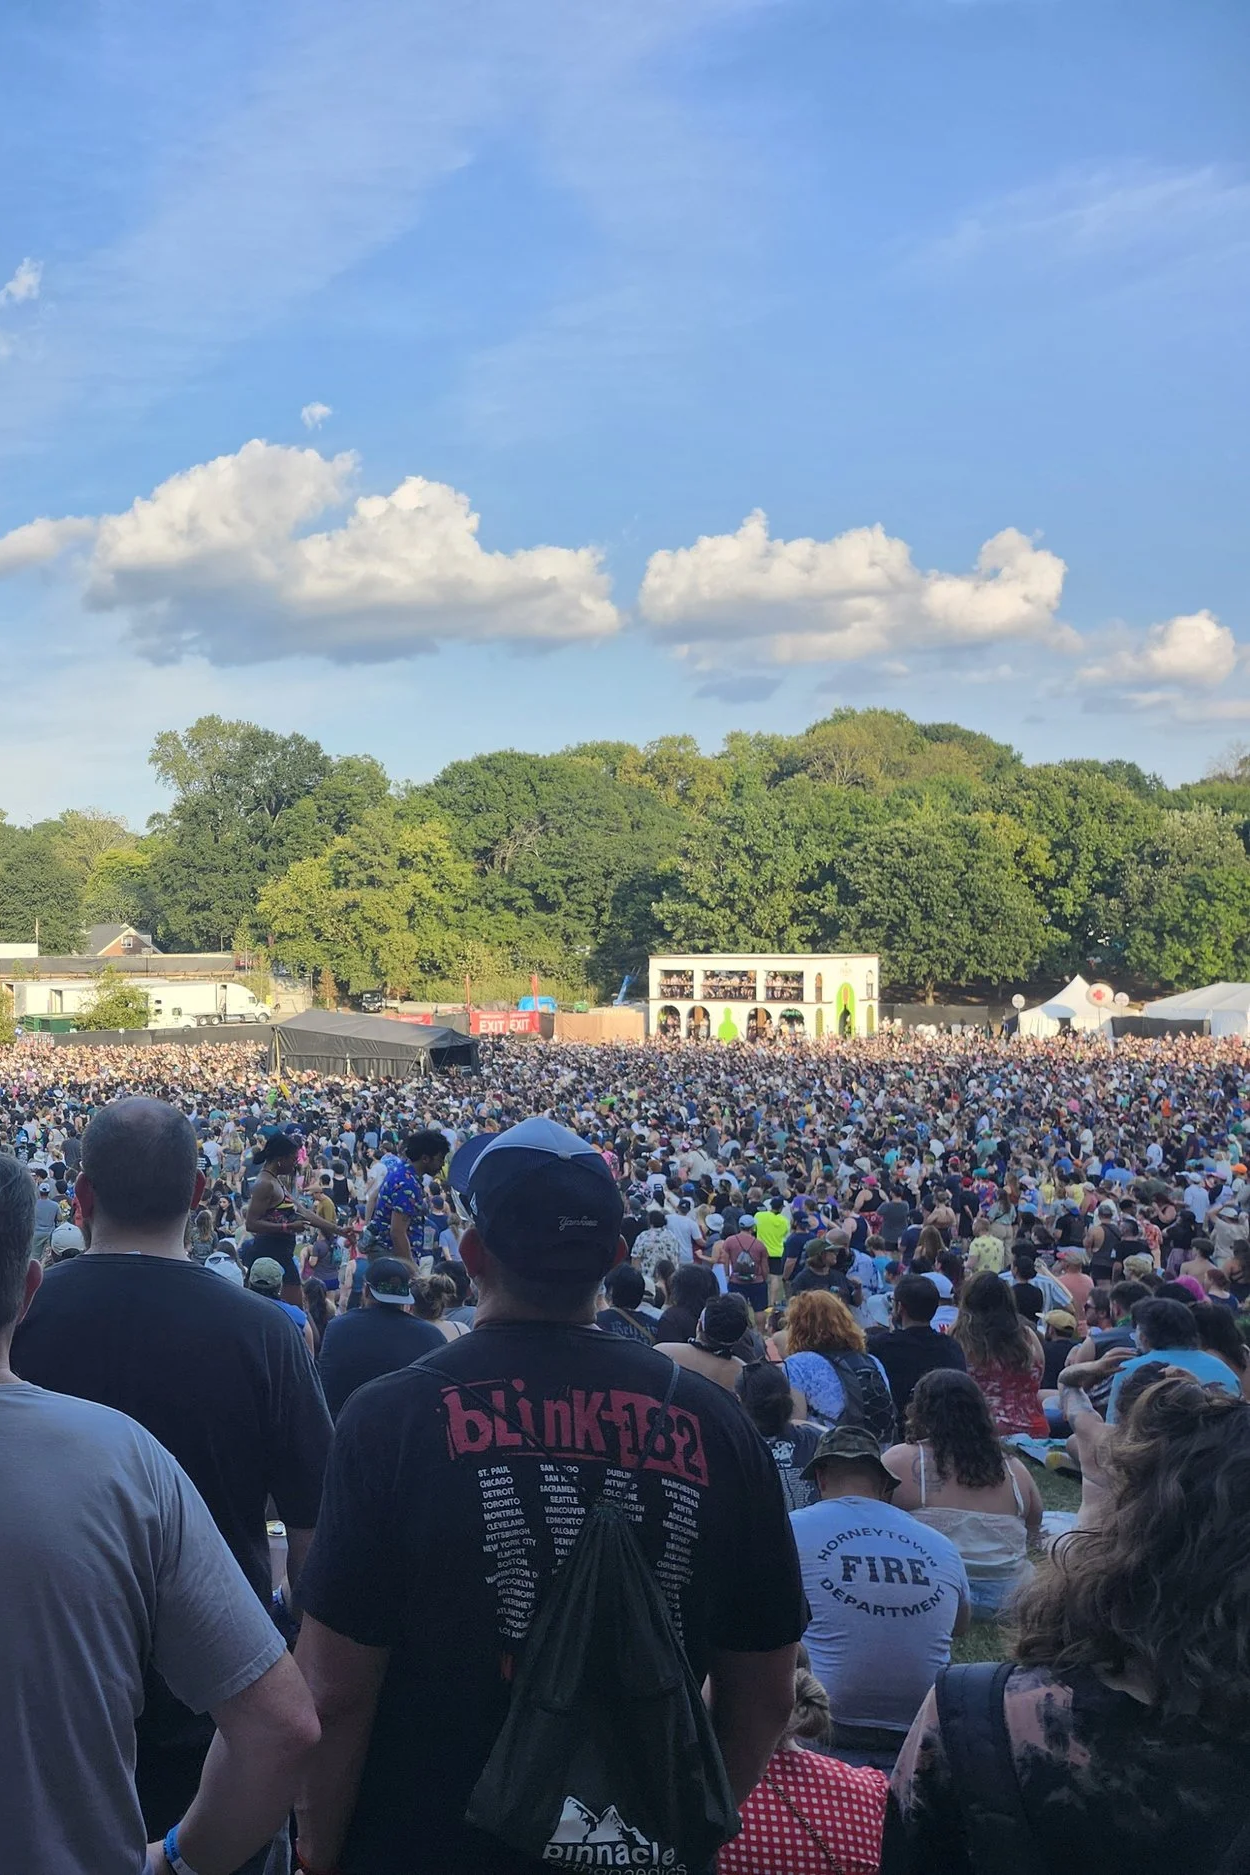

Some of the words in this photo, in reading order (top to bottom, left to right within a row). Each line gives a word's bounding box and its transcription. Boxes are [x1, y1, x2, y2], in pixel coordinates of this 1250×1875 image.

[479, 1021, 504, 1033] EXIT
[510, 1019, 529, 1031] EXIT
[491, 1466, 511, 1475] PAUL
[539, 1464, 555, 1472] SAN
[479, 1476, 513, 1488] CHICAGO
[544, 1474, 559, 1482] SAN
[482, 1487, 515, 1498] DETROIT
[661, 1478, 700, 1499] MANCHESTER
[482, 1497, 521, 1510] TORONTO
[549, 1495, 579, 1504] SEATTLE
[664, 1489, 679, 1500] LAS
[678, 1494, 699, 1509] VEGAS
[483, 1508, 524, 1520] MONTREAL
[544, 1506, 586, 1515] VANCOUVER
[672, 1502, 693, 1516] PERTH
[486, 1518, 526, 1531] CLEVELAND
[545, 1516, 584, 1526] EDMONTO
[667, 1511, 698, 1528] ADELAIDE
[485, 1528, 531, 1541] PITTSBURGH
[483, 1543, 499, 1552] NEW
[499, 1539, 521, 1549] YORK
[496, 1548, 526, 1559] ELMONT
[497, 1558, 528, 1568] BOSTON
[485, 1568, 530, 1584] WASHINGTON
[840, 1555, 931, 1587] FIRE
[496, 1578, 535, 1588] BROOKLYN
[497, 1587, 536, 1599] BALTIMORE
[820, 1577, 945, 1618] DEPARTMENT
[502, 1598, 532, 1609] HERSHEY
[496, 1607, 526, 1619] ATLANTIC
[541, 1841, 675, 1866] pinnacle
